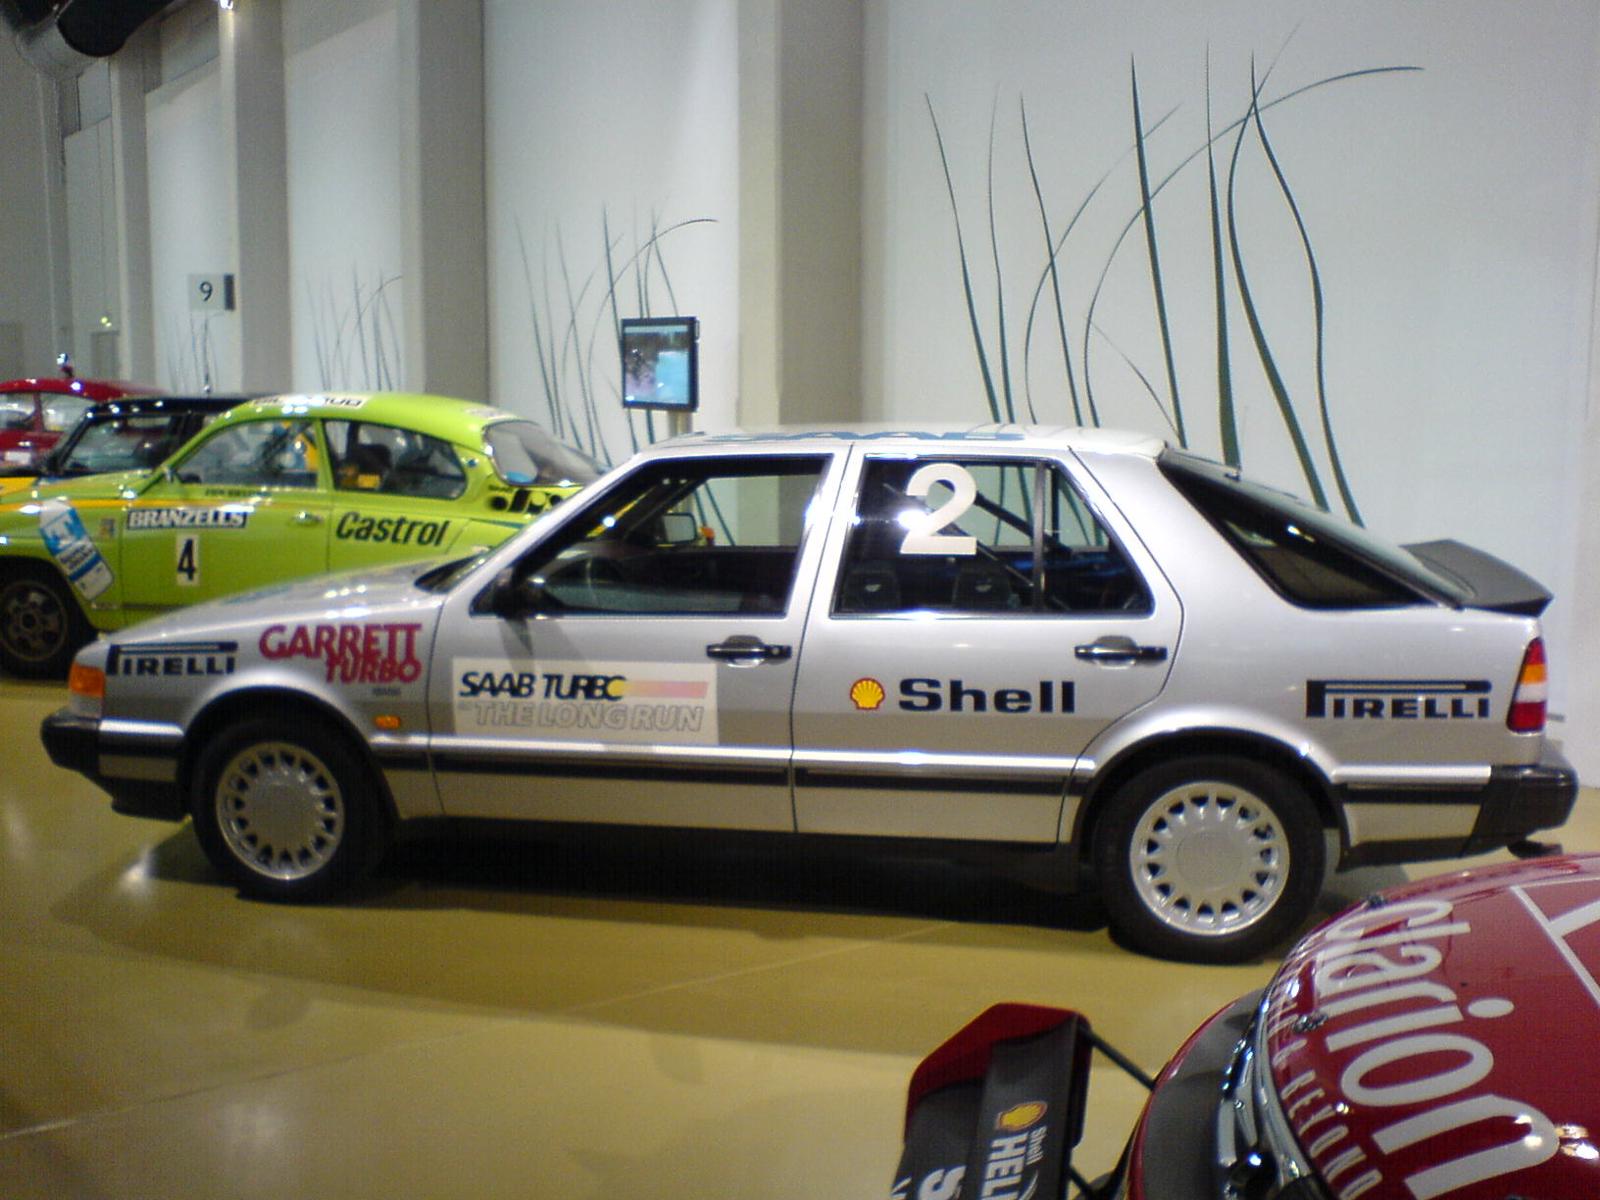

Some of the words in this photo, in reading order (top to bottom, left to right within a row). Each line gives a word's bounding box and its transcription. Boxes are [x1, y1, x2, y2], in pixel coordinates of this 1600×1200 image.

[200, 281, 213, 302] 9
[900, 463, 977, 555] 2
[336, 511, 450, 547] Castrol
[177, 538, 195, 581] 4
[105, 641, 238, 676] PIRELLI
[259, 624, 422, 660] GARRETT
[325, 655, 422, 684] TURBO
[459, 671, 536, 698] SAAB
[899, 677, 1075, 713] Shell
[1306, 680, 1492, 718] PIRELLI
[474, 702, 537, 727] THE
[538, 703, 628, 730] LONG
[630, 705, 704, 732] RUN
[1026, 1126, 1048, 1166] Shell
